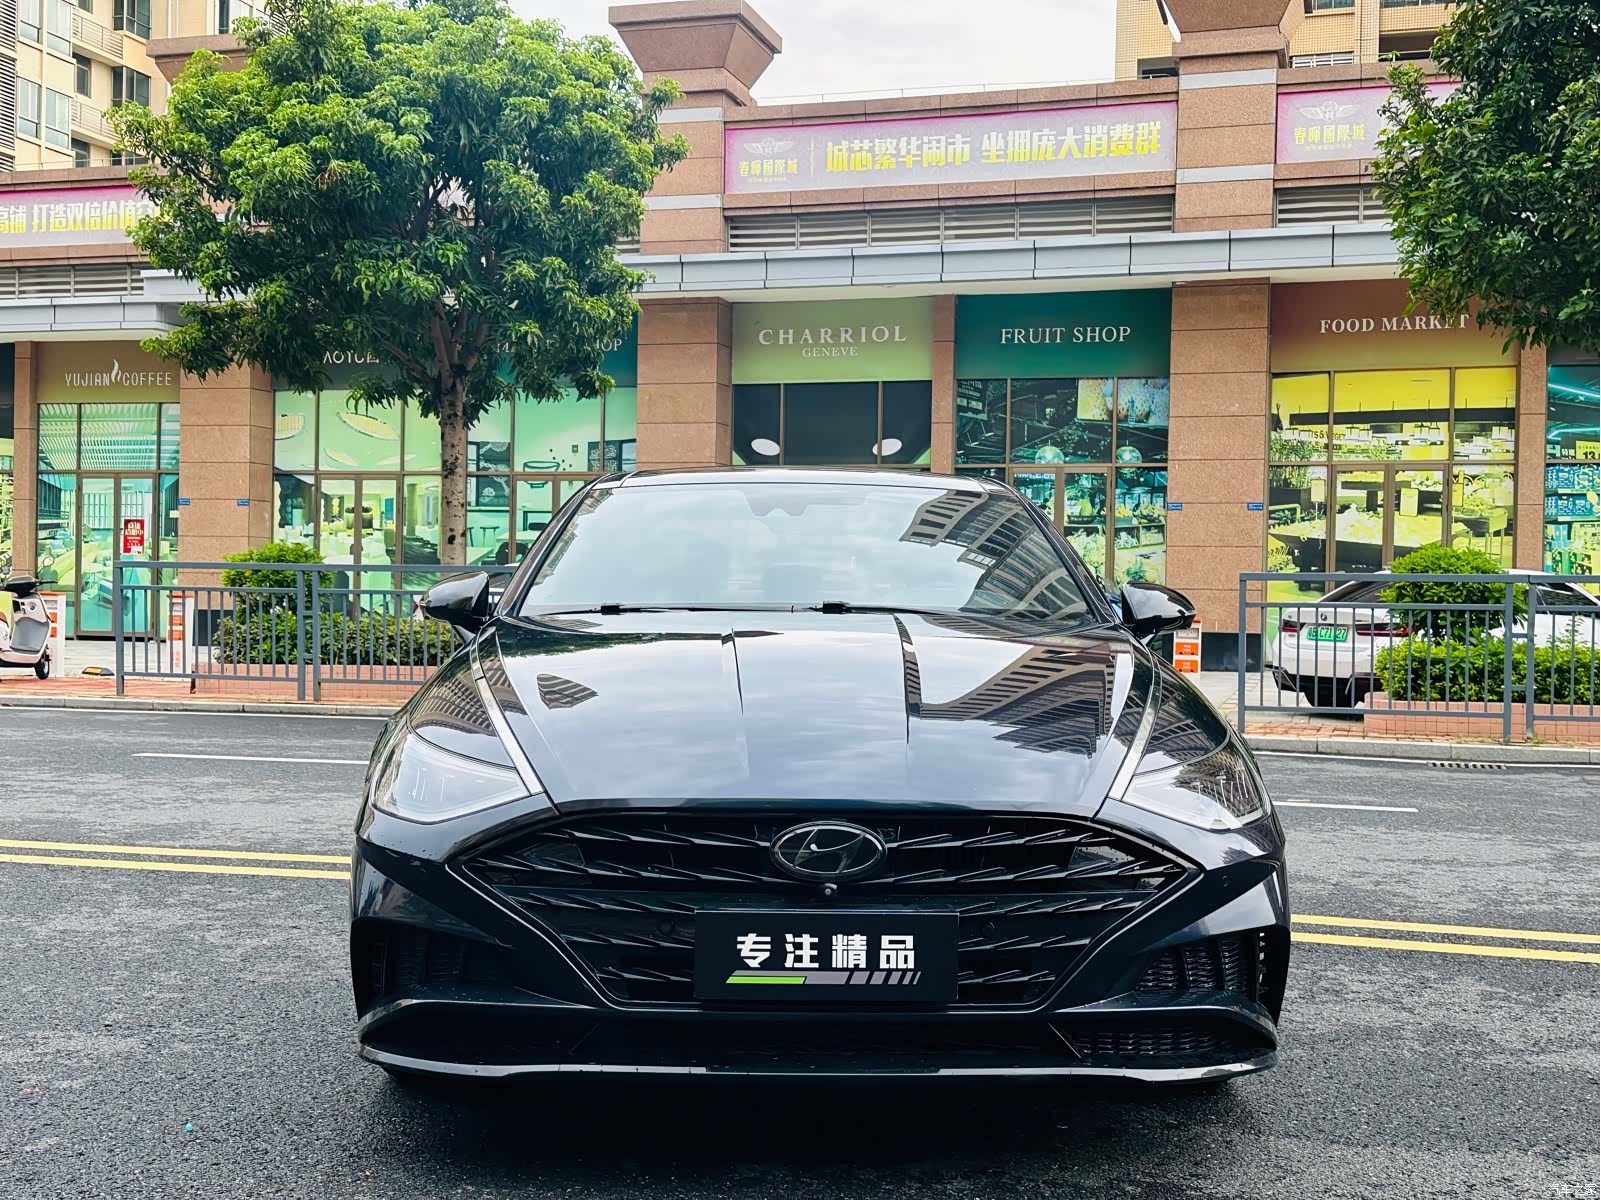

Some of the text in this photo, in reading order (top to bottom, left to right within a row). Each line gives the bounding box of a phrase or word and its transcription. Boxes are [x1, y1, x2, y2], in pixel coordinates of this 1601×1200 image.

[826, 120, 1161, 173] 城芯繁华闹市 坐拥庞大消费群
[758, 325, 908, 345] CHARRIOL
[1319, 317, 1375, 334] FOOD
[1000, 326, 1131, 345] FRUIT SHOP
[802, 346, 858, 358] GENEVE
[64, 371, 172, 387] YUJIAN COFFEE
[736, 932, 916, 970] 专注精品
